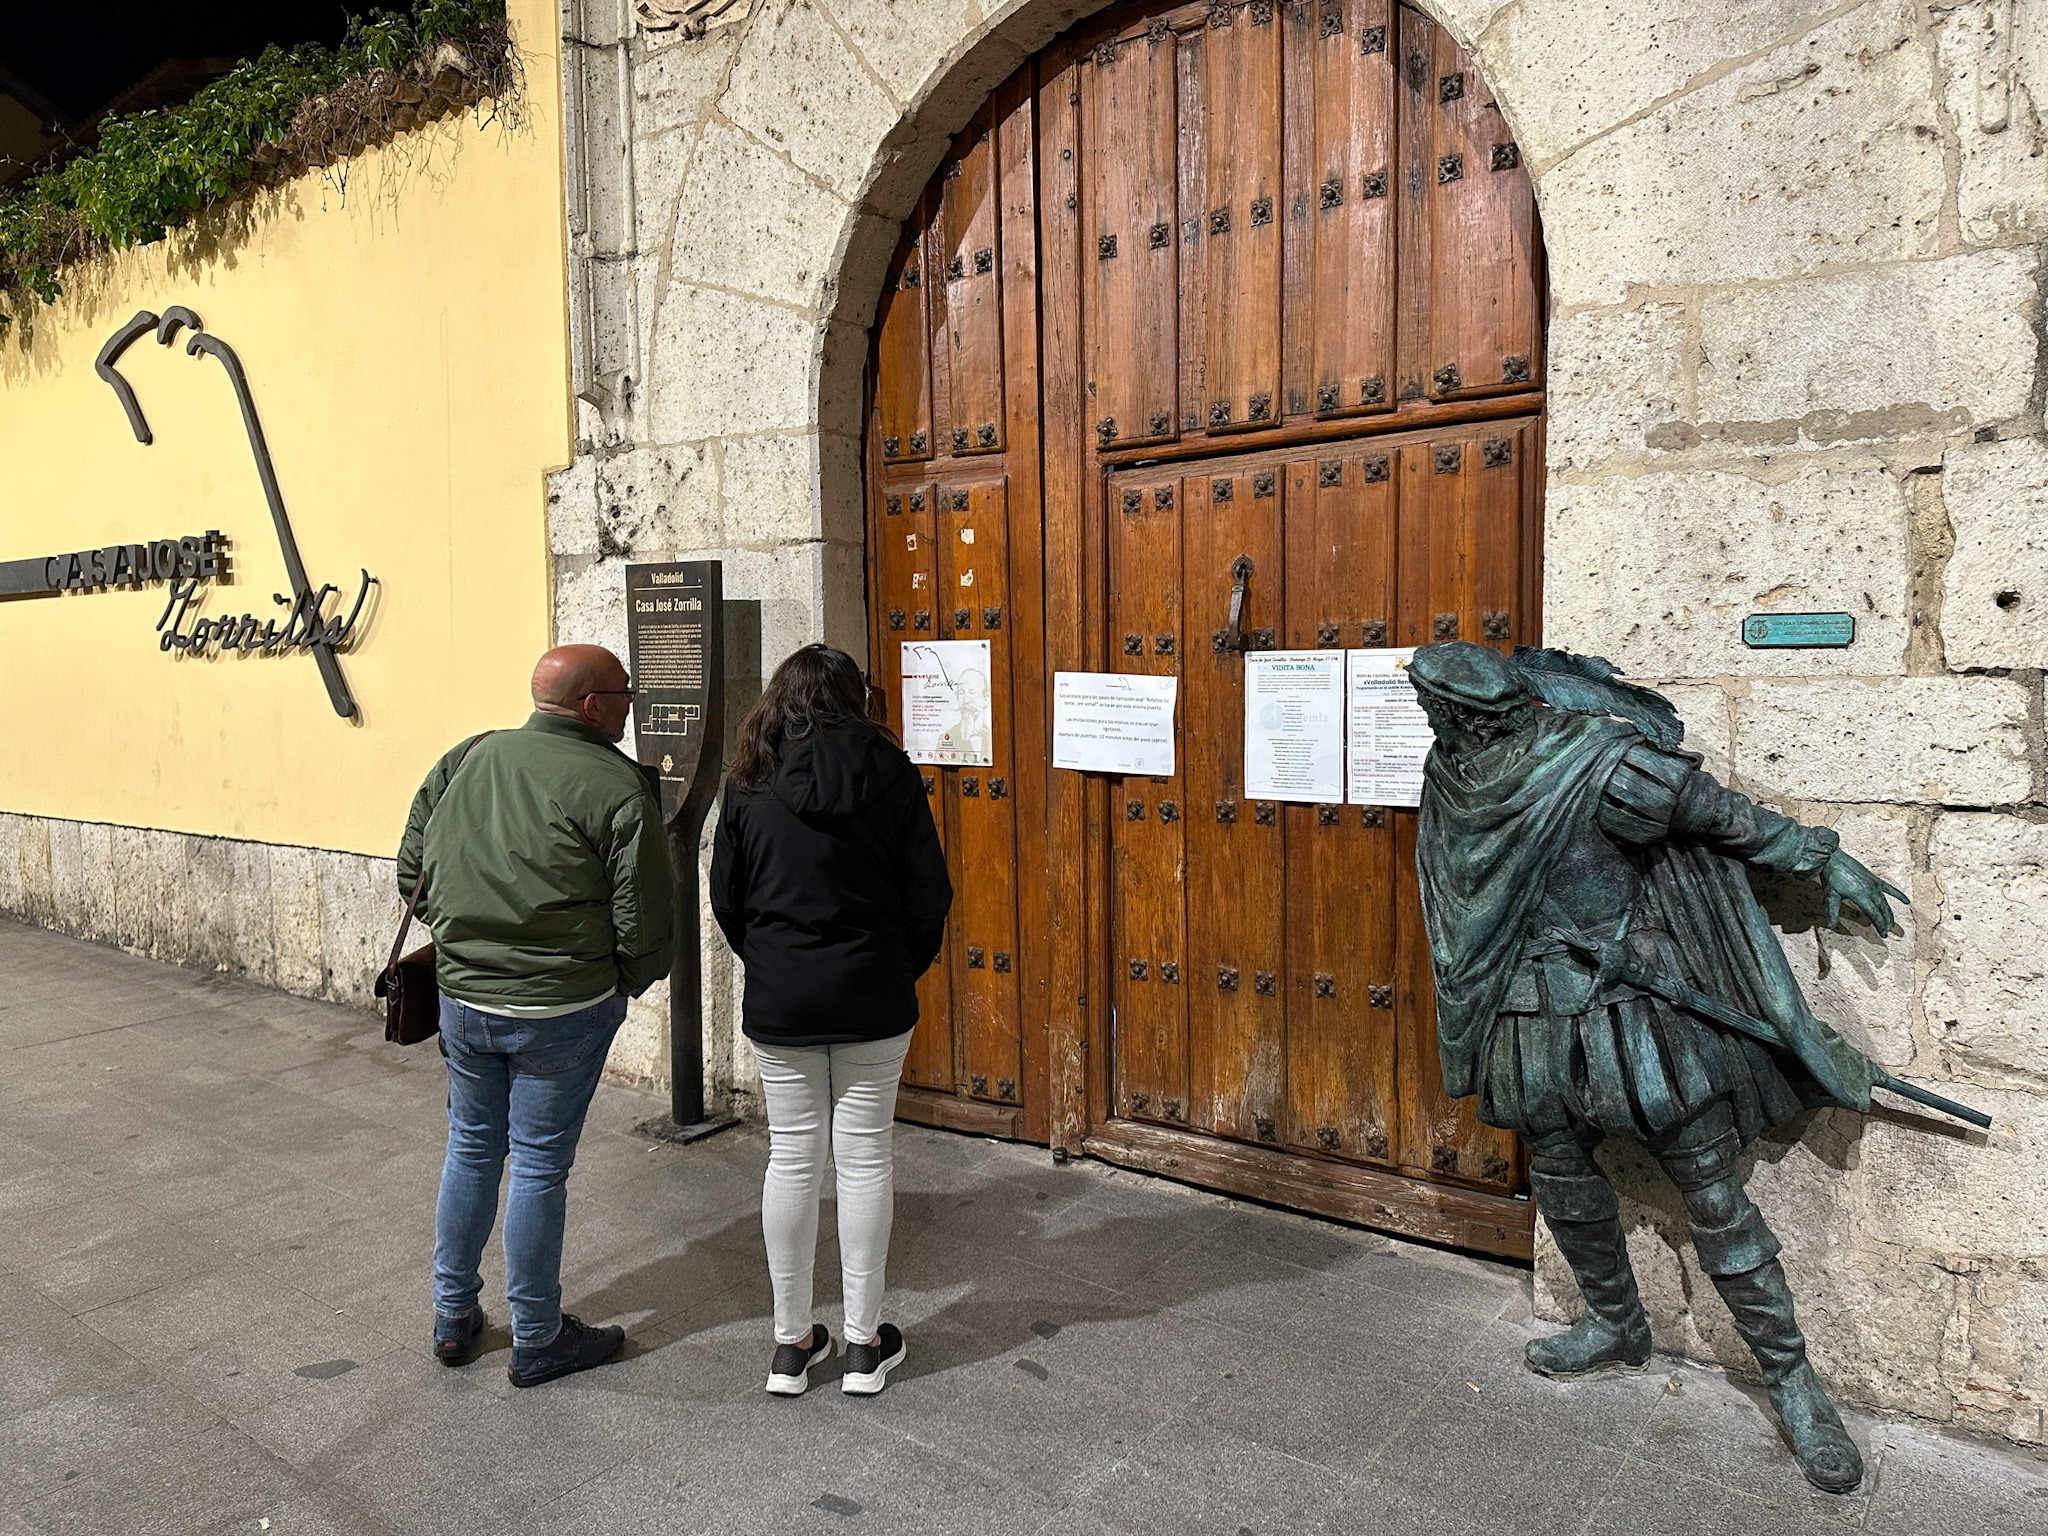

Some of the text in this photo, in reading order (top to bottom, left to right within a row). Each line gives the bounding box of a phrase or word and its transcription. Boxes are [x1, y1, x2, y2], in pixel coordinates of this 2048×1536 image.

[651, 571, 684, 584] Valladolid
[636, 597, 702, 612] Casa José Zorrilla
